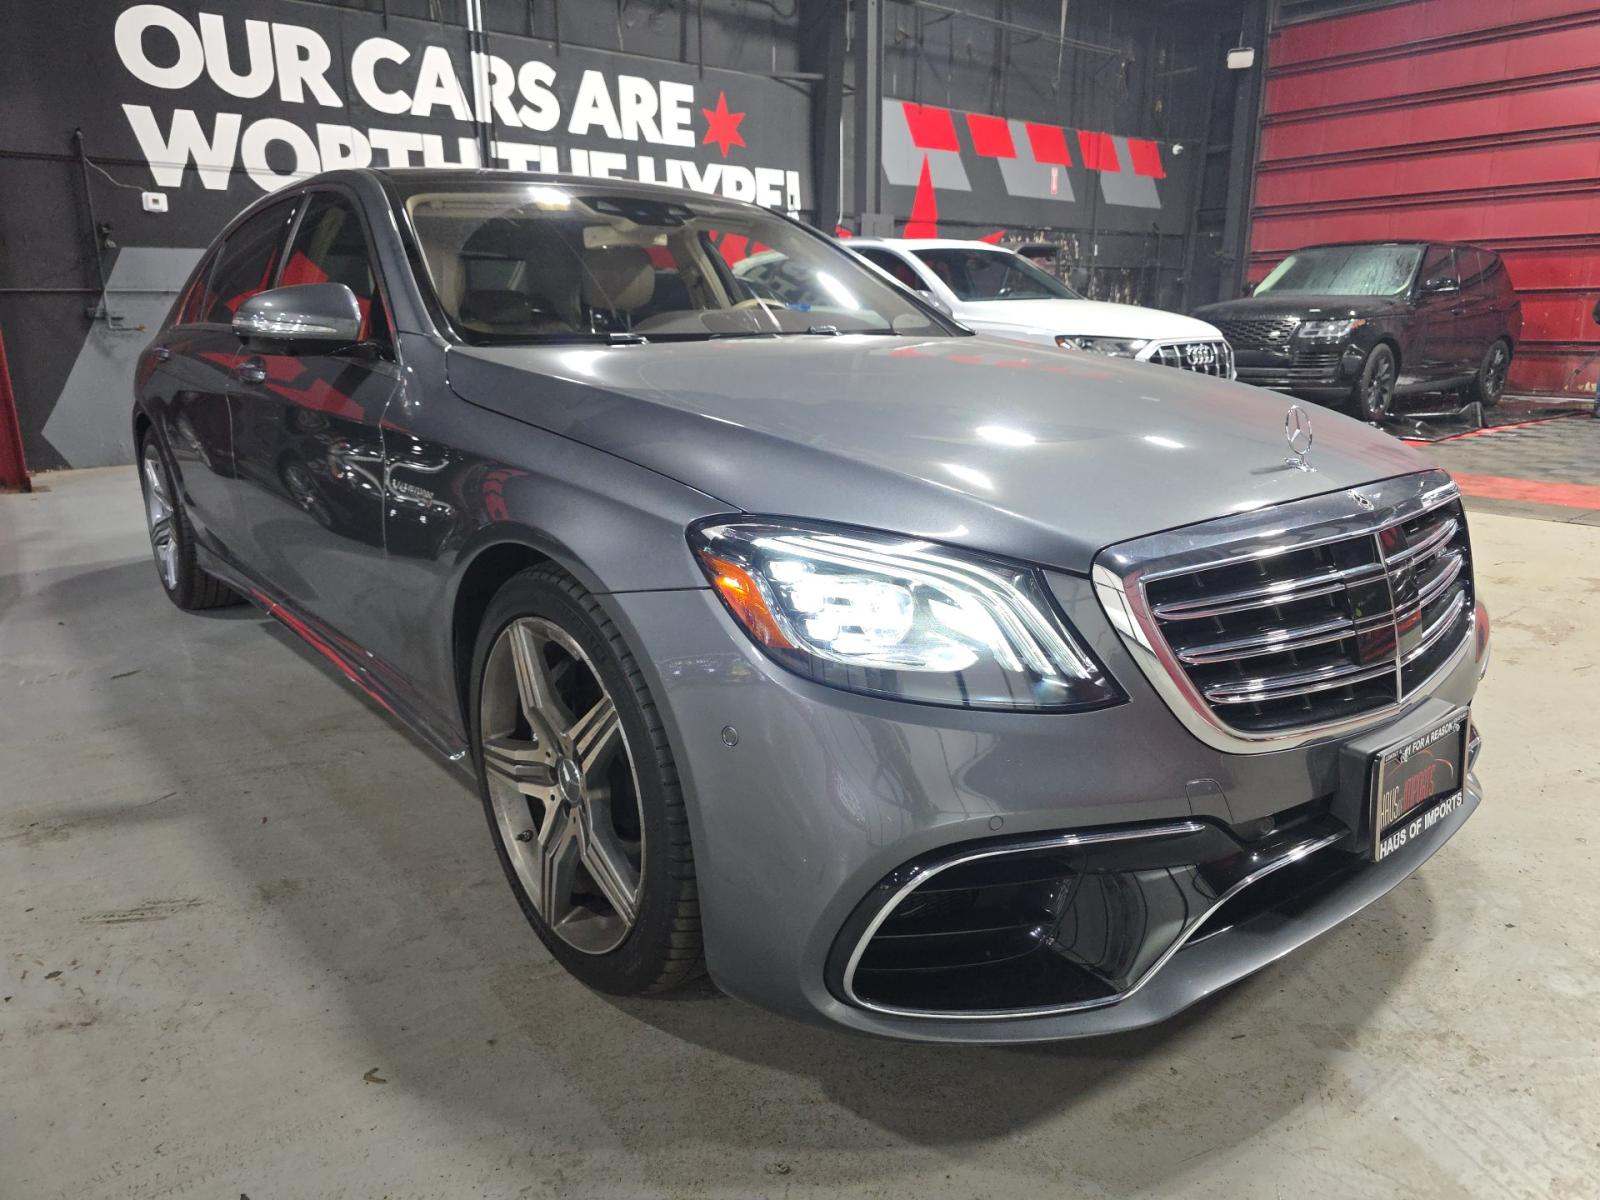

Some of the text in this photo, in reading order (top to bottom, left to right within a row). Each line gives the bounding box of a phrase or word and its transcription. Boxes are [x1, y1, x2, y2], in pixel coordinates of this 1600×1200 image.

[114, 4, 696, 148] OUR CARS ARE
[1412, 737, 1426, 753] FOR
[1425, 734, 1431, 747] A
[1430, 721, 1454, 743] REASON
[1379, 828, 1407, 860] HAUS
[1409, 817, 1423, 839] OF
[1424, 791, 1463, 831] IMPORTS
